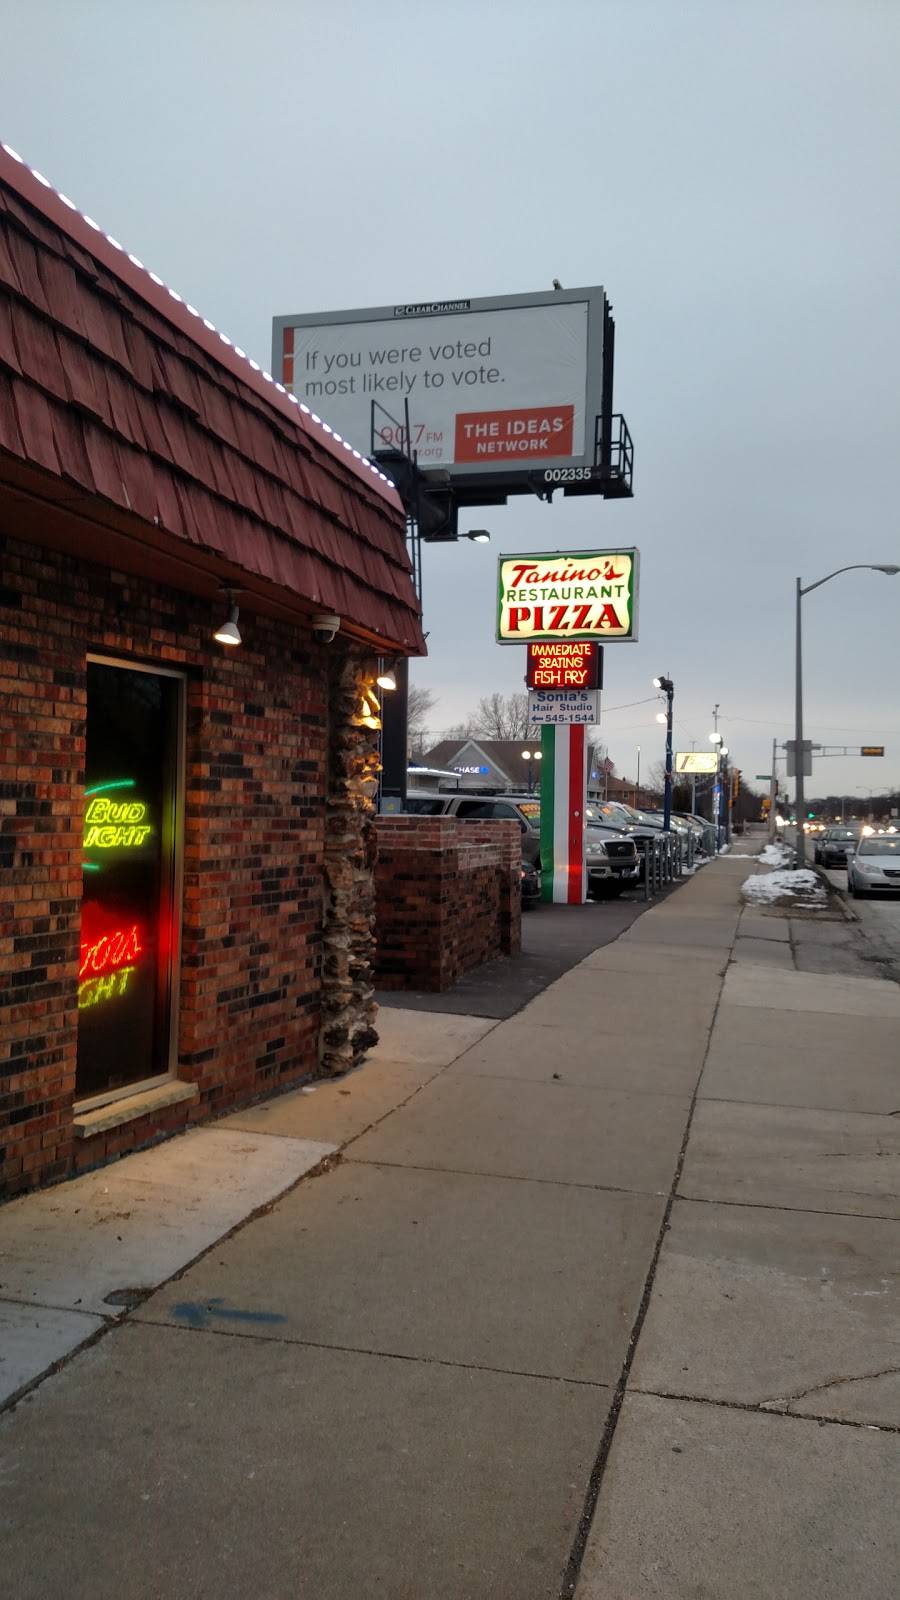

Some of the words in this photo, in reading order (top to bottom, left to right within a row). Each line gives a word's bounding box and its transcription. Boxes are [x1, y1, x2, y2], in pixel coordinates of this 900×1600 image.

[305, 351, 319, 370] If
[323, 356, 361, 374] you
[368, 348, 422, 366] were
[428, 337, 491, 360] voted
[305, 377, 355, 397] most
[362, 372, 416, 398] likely
[424, 370, 444, 388] to
[451, 365, 505, 387] vote.
[464, 423, 499, 438] THE
[506, 417, 564, 435] IDEAS
[426, 432, 443, 443] FM
[476, 438, 548, 454] NETWORK
[544, 467, 592, 481] 002335
[510, 560, 625, 588] Tanino's
[506, 585, 625, 602] RESTAURANT
[507, 604, 624, 631] PIZZA
[531, 644, 591, 656] IMMEDIATE
[539, 657, 583, 668] SEATING
[534, 671, 561, 684] FISH
[564, 670, 588, 684] FRY
[537, 691, 588, 702] Sonia's
[532, 704, 553, 712] Hair
[559, 703, 593, 712] Studio
[545, 714, 594, 723] 545-1544
[454, 766, 480, 774] CHASE
[85, 798, 146, 823] BUD
